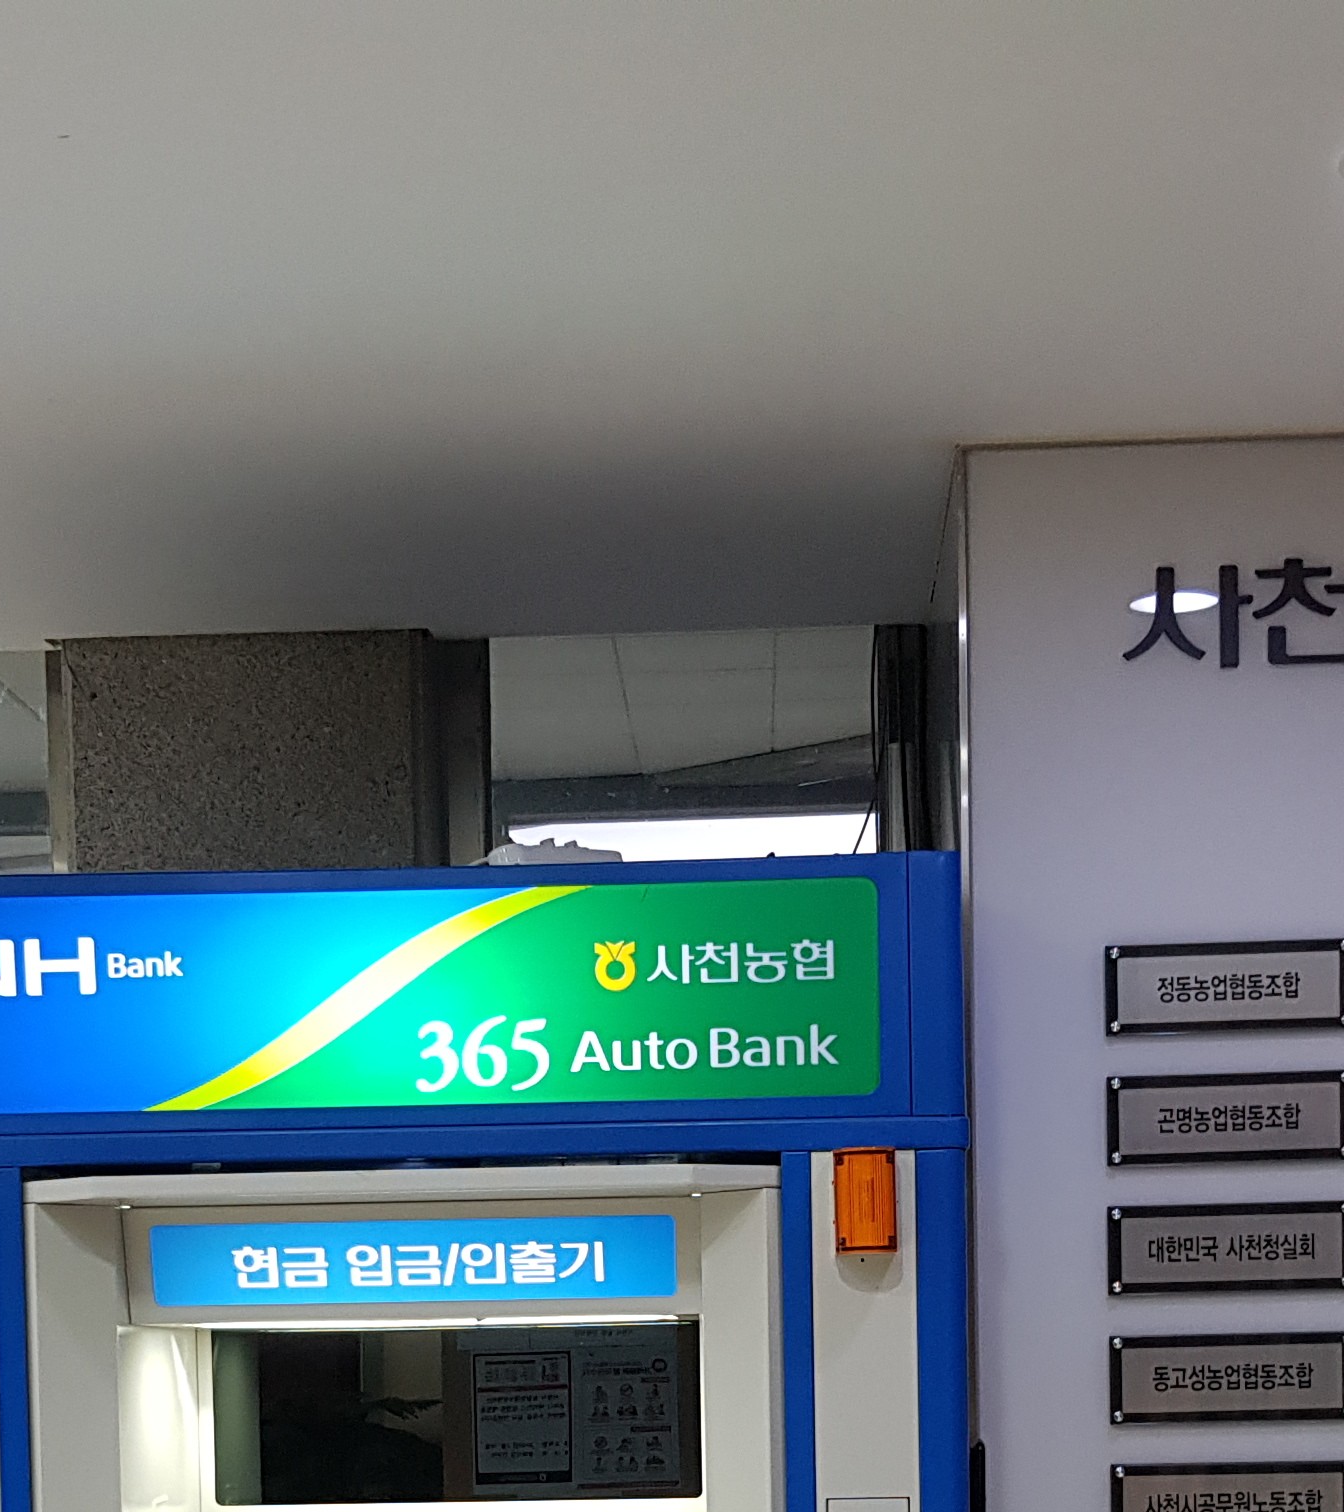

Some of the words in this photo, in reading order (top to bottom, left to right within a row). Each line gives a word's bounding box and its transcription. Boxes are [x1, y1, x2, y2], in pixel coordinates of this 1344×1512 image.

[107, 951, 183, 979] Bank
[646, 939, 834, 985] 사천농협
[1157, 972, 1301, 1003] 정동농업협동조합
[415, 1015, 550, 1092] 365
[570, 1030, 698, 1072] Auto
[710, 1024, 839, 1068] Bank
[1157, 1103, 1301, 1134] 곤명농업협동조합
[1148, 1236, 1218, 1263] 대한민국
[1226, 1233, 1315, 1261] 사천청실회
[230, 1246, 329, 1288] 현금
[346, 1241, 605, 1287] 입금/인출기
[1152, 1363, 1314, 1391] 동고성농업협동조합
